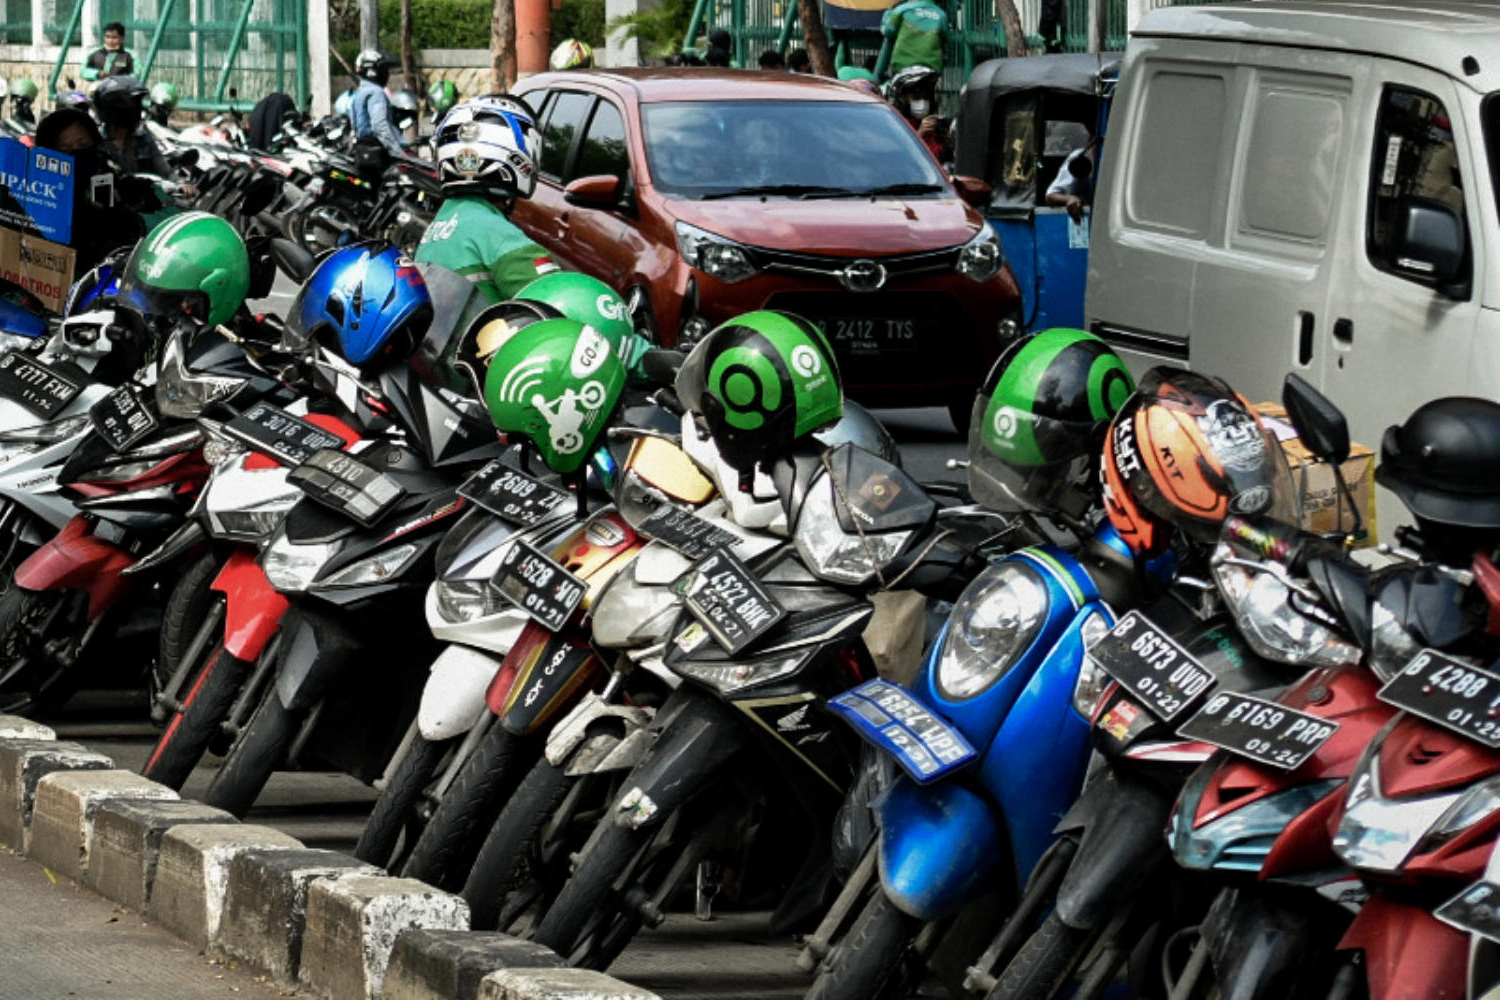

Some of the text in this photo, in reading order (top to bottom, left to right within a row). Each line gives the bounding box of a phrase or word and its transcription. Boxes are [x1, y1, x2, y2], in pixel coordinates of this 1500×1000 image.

[835, 320, 874, 339] 2412
[885, 320, 915, 339] TYS
[1160, 446, 1185, 481] KYT
[504, 544, 521, 566] B
[710, 570, 749, 607] 4522
[1112, 615, 1137, 637] B
[1130, 630, 1178, 671] 6673
[1404, 653, 1489, 698] B 4288
[1203, 696, 1332, 746] B 6169 PRP
